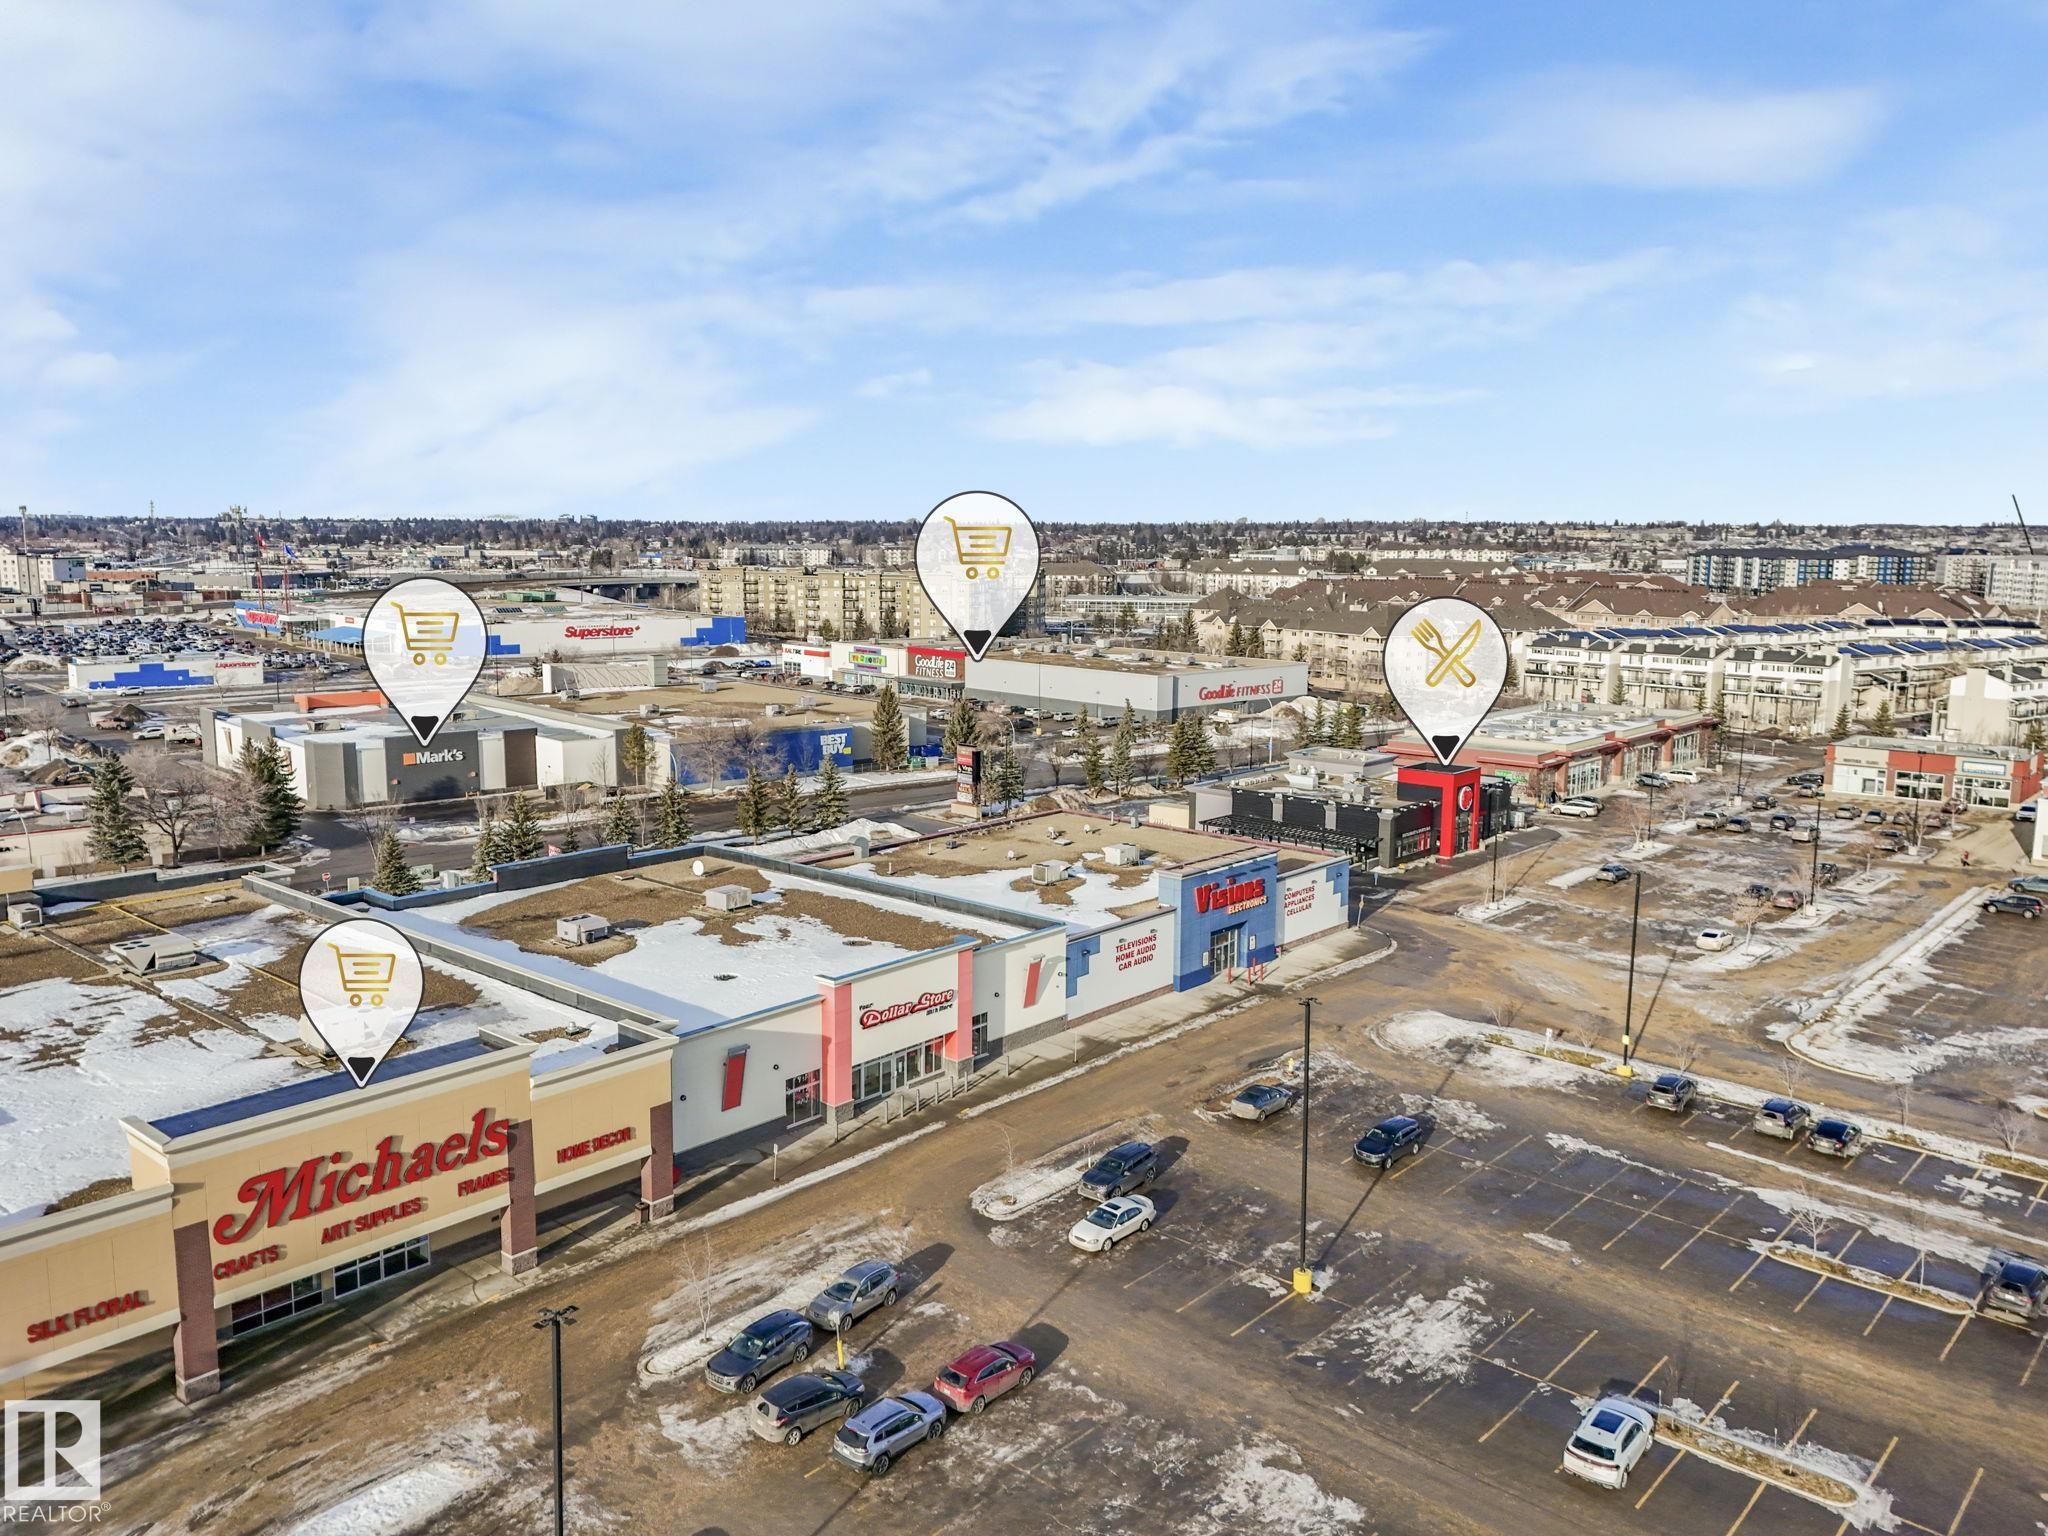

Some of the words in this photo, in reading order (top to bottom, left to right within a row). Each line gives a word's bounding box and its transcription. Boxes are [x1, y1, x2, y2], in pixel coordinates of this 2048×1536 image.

[565, 625, 634, 640] Superstore
[215, 661, 256, 669] Liquorstore
[915, 654, 944, 668] GoodLife
[946, 661, 955, 670] 24
[915, 666, 944, 678] FITNESS
[1199, 683, 1236, 700] GoodLife
[1236, 683, 1271, 697] FITNESS
[820, 733, 847, 745] BEST
[415, 749, 464, 764] Mark's
[822, 743, 846, 755] BUY
[1195, 877, 1266, 913] Visions
[1284, 885, 1315, 901] COMPUTERS
[1284, 893, 1315, 909] APPLIANCES
[1228, 896, 1268, 914] ELECTRONICS
[1286, 902, 1312, 917] CELLULAR
[1115, 934, 1157, 953] TELEVISIONS
[1115, 950, 1135, 963] HOME
[1136, 943, 1157, 956] AUDIO
[1118, 960, 1132, 971] CAR
[1133, 953, 1154, 967] AUDIO
[860, 1002, 913, 1029] Dollar
[911, 989, 954, 1014] Store
[556, 1140, 592, 1164] HOME
[592, 1127, 631, 1152] DECOR
[213, 1108, 510, 1245] Michaels
[457, 1166, 513, 1198] FRAMES
[321, 1219, 350, 1245] ART
[355, 1197, 422, 1232] SUPPLIES
[213, 1244, 281, 1281] CRAFTS
[27, 1313, 70, 1344] SILK
[73, 1289, 146, 1328] FLORAL
